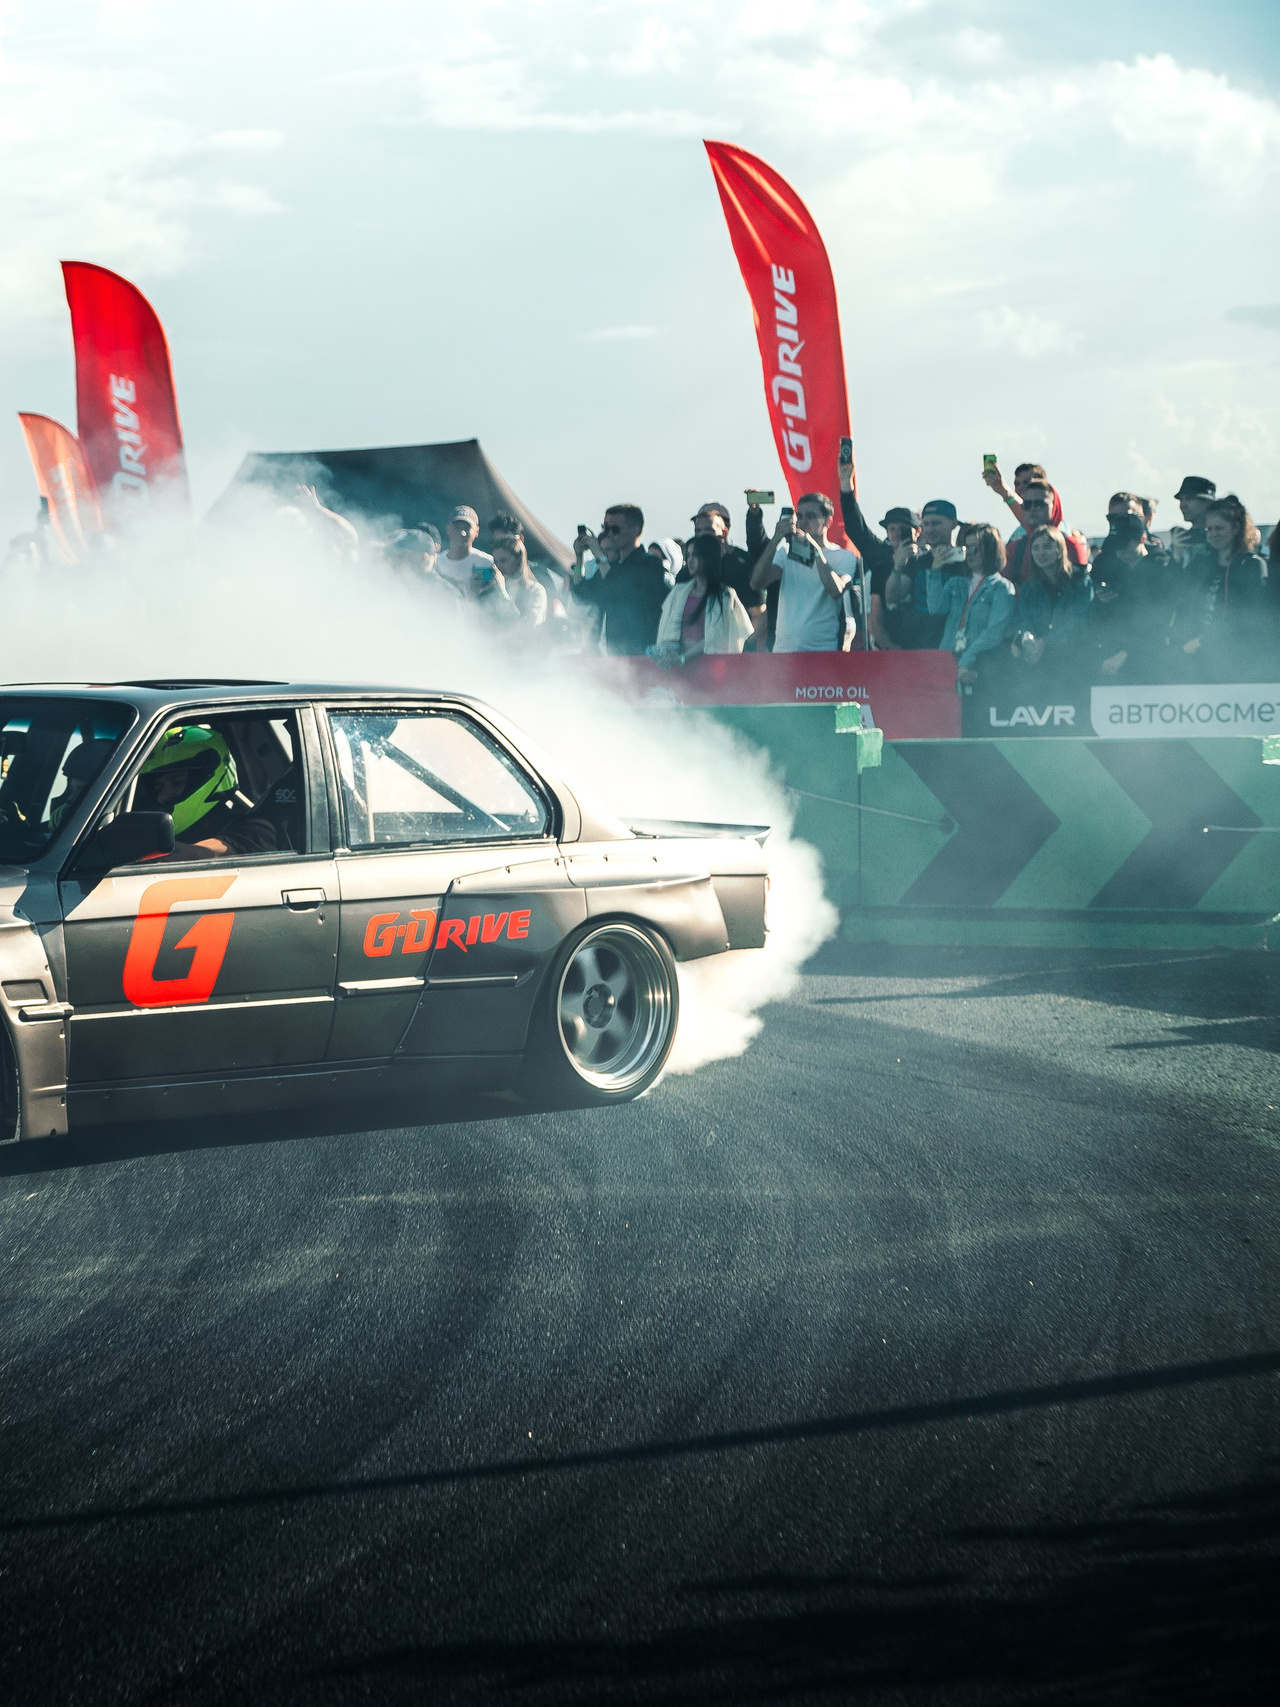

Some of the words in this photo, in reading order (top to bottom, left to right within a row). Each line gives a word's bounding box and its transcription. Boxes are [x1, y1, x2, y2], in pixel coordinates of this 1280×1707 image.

[795, 686, 844, 700] MOTOR
[847, 685, 870, 699] OIL
[989, 704, 1076, 728] LAVR
[1107, 701, 1280, 725] автокосме
[122, 875, 239, 1009] G
